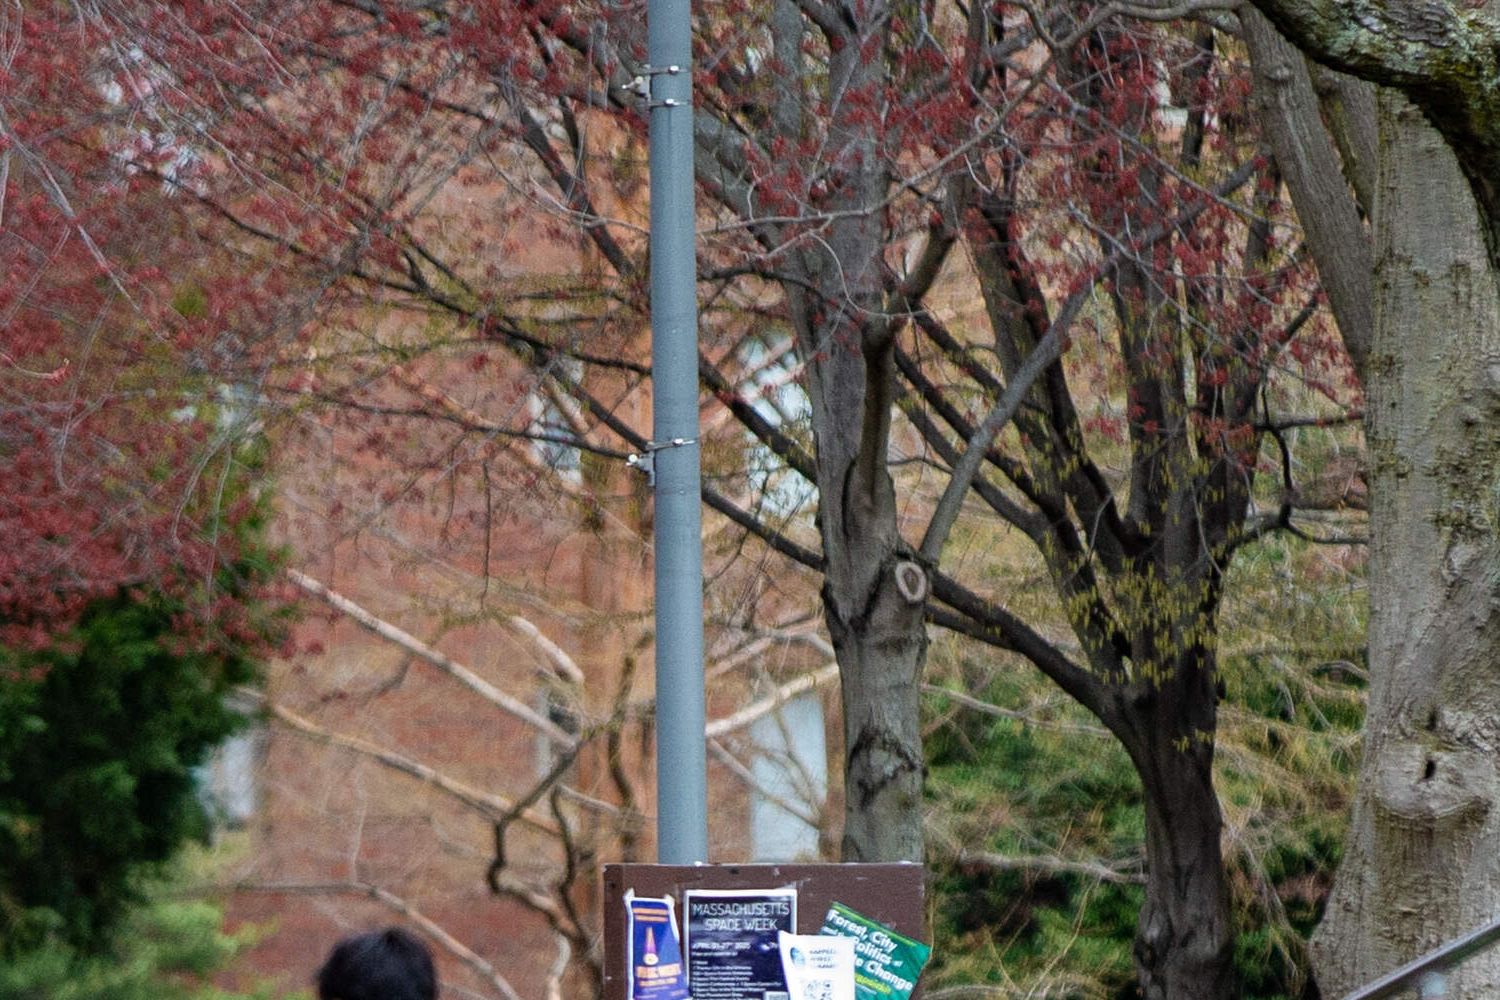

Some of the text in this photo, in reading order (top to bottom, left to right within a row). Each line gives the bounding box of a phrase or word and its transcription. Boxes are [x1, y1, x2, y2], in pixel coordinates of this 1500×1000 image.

[691, 902, 790, 916] MASSACHUSETTS
[704, 918, 778, 931] SPACE WEEK
[826, 909, 868, 941] Forest,
[869, 931, 898, 952] City
[864, 960, 913, 990] Change
